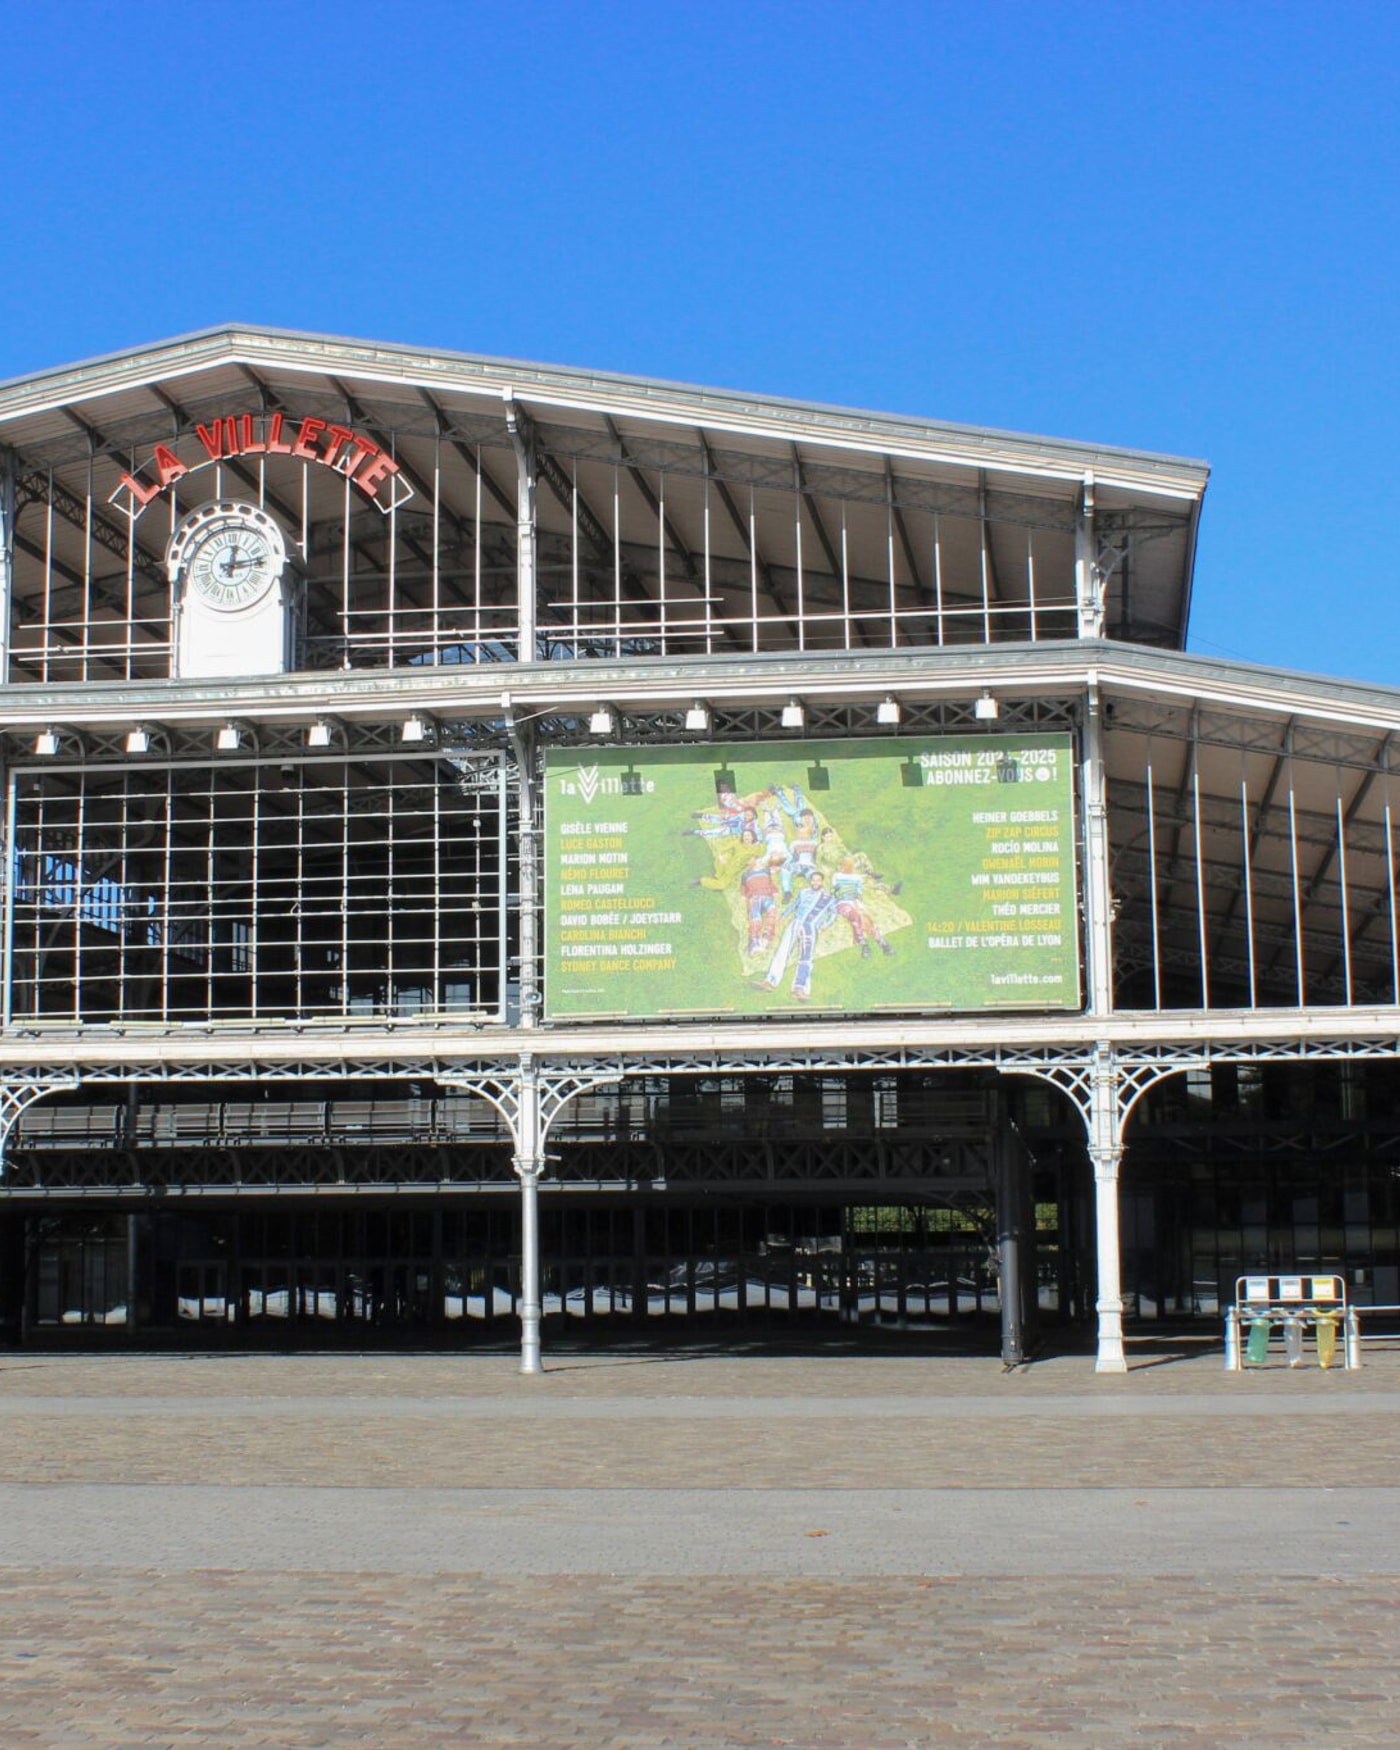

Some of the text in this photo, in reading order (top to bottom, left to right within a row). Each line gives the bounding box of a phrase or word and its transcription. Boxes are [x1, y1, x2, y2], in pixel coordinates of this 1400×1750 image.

[119, 413, 399, 504] LA VILLETTE
[921, 751, 971, 767] SAISON
[926, 767, 1033, 785] ABONNEZ-VOUS
[560, 779, 576, 795] la
[972, 810, 1058, 823] HEINER GOEBBELS
[561, 821, 628, 835] GISÈLE VIENNE
[1004, 827, 1021, 838] ZAP
[1024, 826, 1058, 837] CIRCUS
[992, 840, 1059, 853] ROCÍO MOLINA
[560, 852, 628, 865] MARION MOTIN
[971, 872, 1059, 885] WIM VANDEKEYBUS
[561, 883, 624, 895] LENA PAUGAM
[561, 898, 655, 911] ROMEO CASTELLUCCI
[993, 902, 1060, 915] THÉO MERCIER
[561, 914, 587, 926] DAVID
[630, 912, 681, 924] JOEYSTARR
[965, 920, 1016, 931] VALENTINE
[1019, 919, 1062, 930] LOSSEAU
[561, 928, 646, 941] CAROLINA BIANCHI
[928, 936, 962, 948] BALLET
[966, 936, 978, 947] DE
[1022, 935, 1034, 946] DE
[1037, 934, 1061, 946] LYON
[561, 943, 672, 956] FLORENTINA HOLZINGER
[561, 958, 676, 972] SYDNEY DANCE COMPANY
